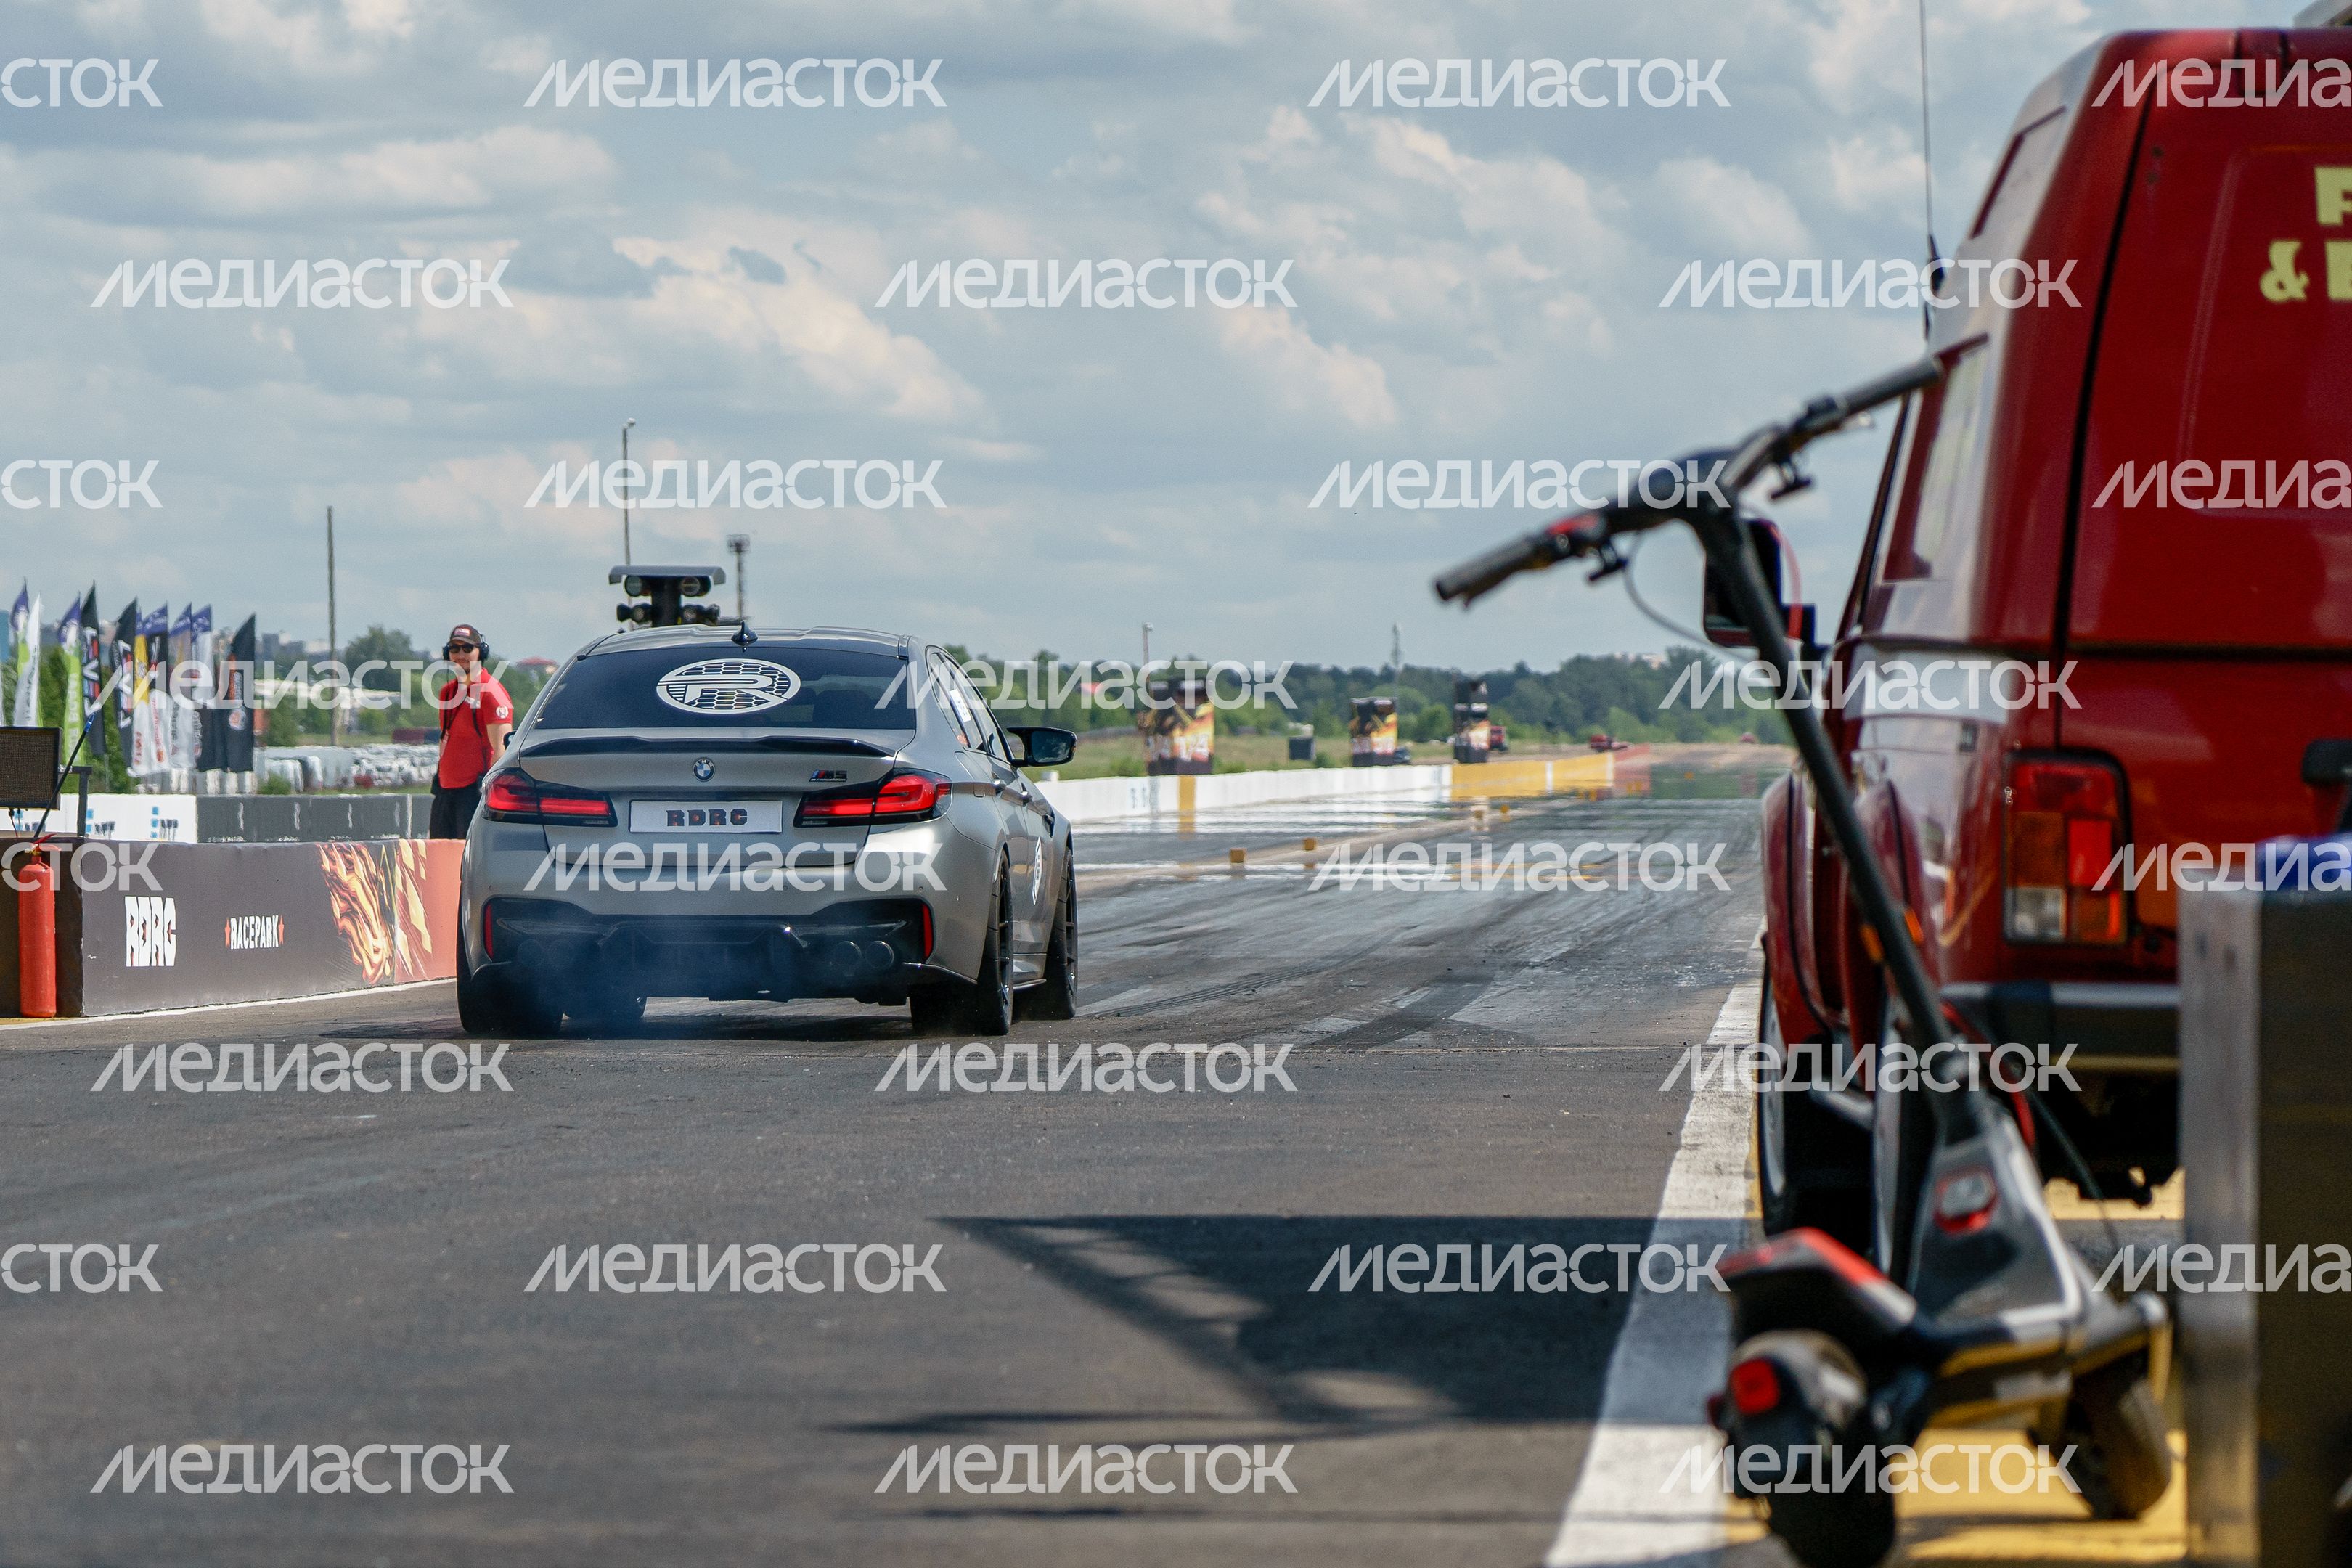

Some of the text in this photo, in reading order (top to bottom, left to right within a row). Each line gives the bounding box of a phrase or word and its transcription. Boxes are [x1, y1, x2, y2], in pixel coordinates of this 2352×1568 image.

[666, 808, 748, 826] RDRC
[125, 896, 176, 967] RDRC
[230, 915, 279, 950] RACEPARK
